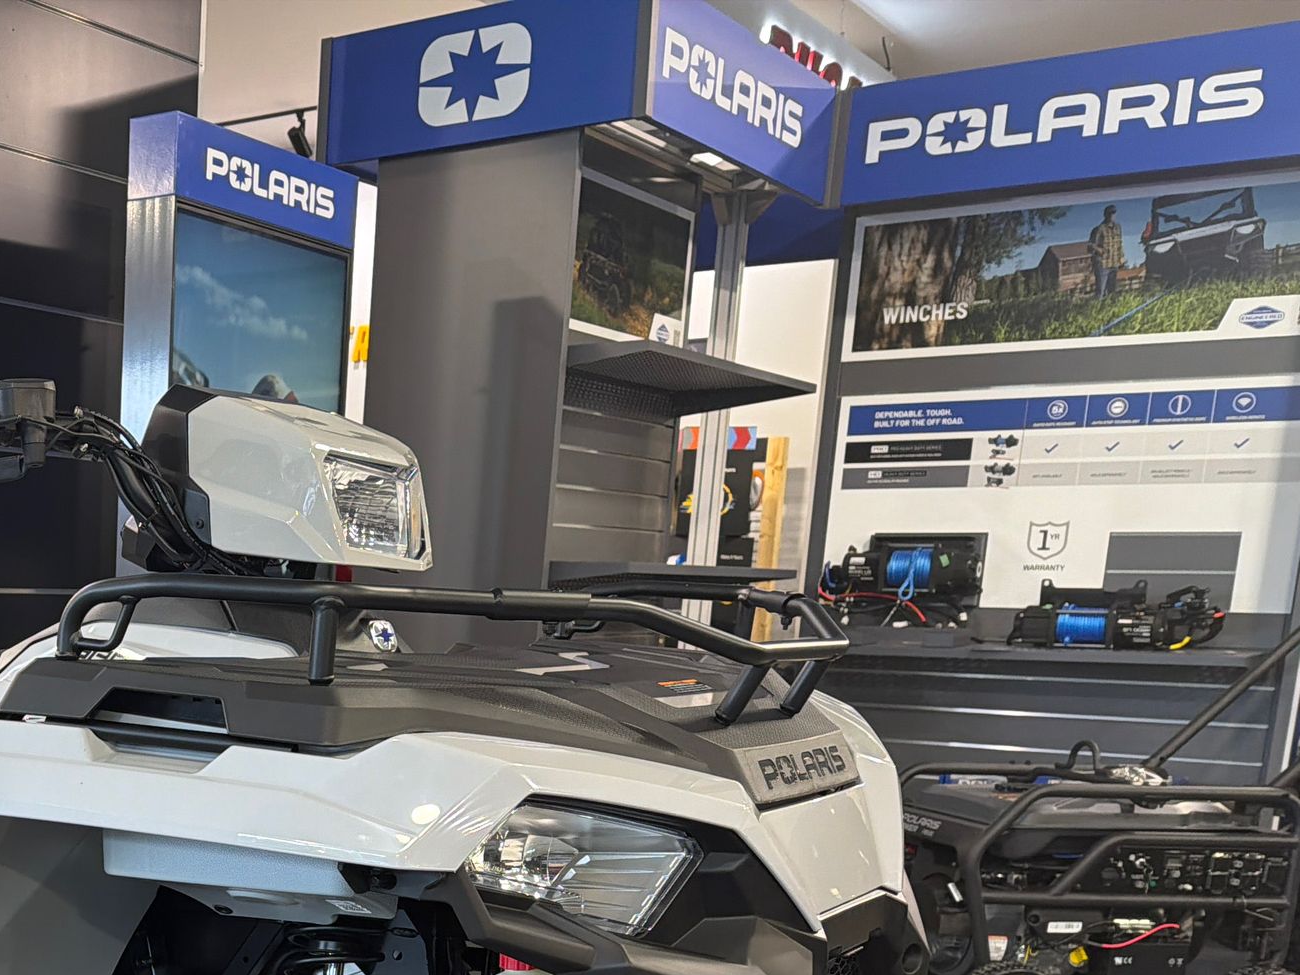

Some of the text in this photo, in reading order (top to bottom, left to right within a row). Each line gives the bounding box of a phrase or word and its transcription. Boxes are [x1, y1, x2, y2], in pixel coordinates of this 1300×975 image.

[662, 26, 803, 148] POLARIS
[864, 68, 1265, 165] POLARIS
[206, 147, 335, 219] POLARIS
[883, 302, 969, 325] WINCHES
[873, 417, 965, 429] BUILT FOR THE OFF ROAD.
[874, 408, 952, 420] DEPENDABLE. TOUGH.
[1037, 530, 1050, 551] 1
[1023, 564, 1066, 572] WARRANTY
[758, 745, 847, 791] POLARIS
